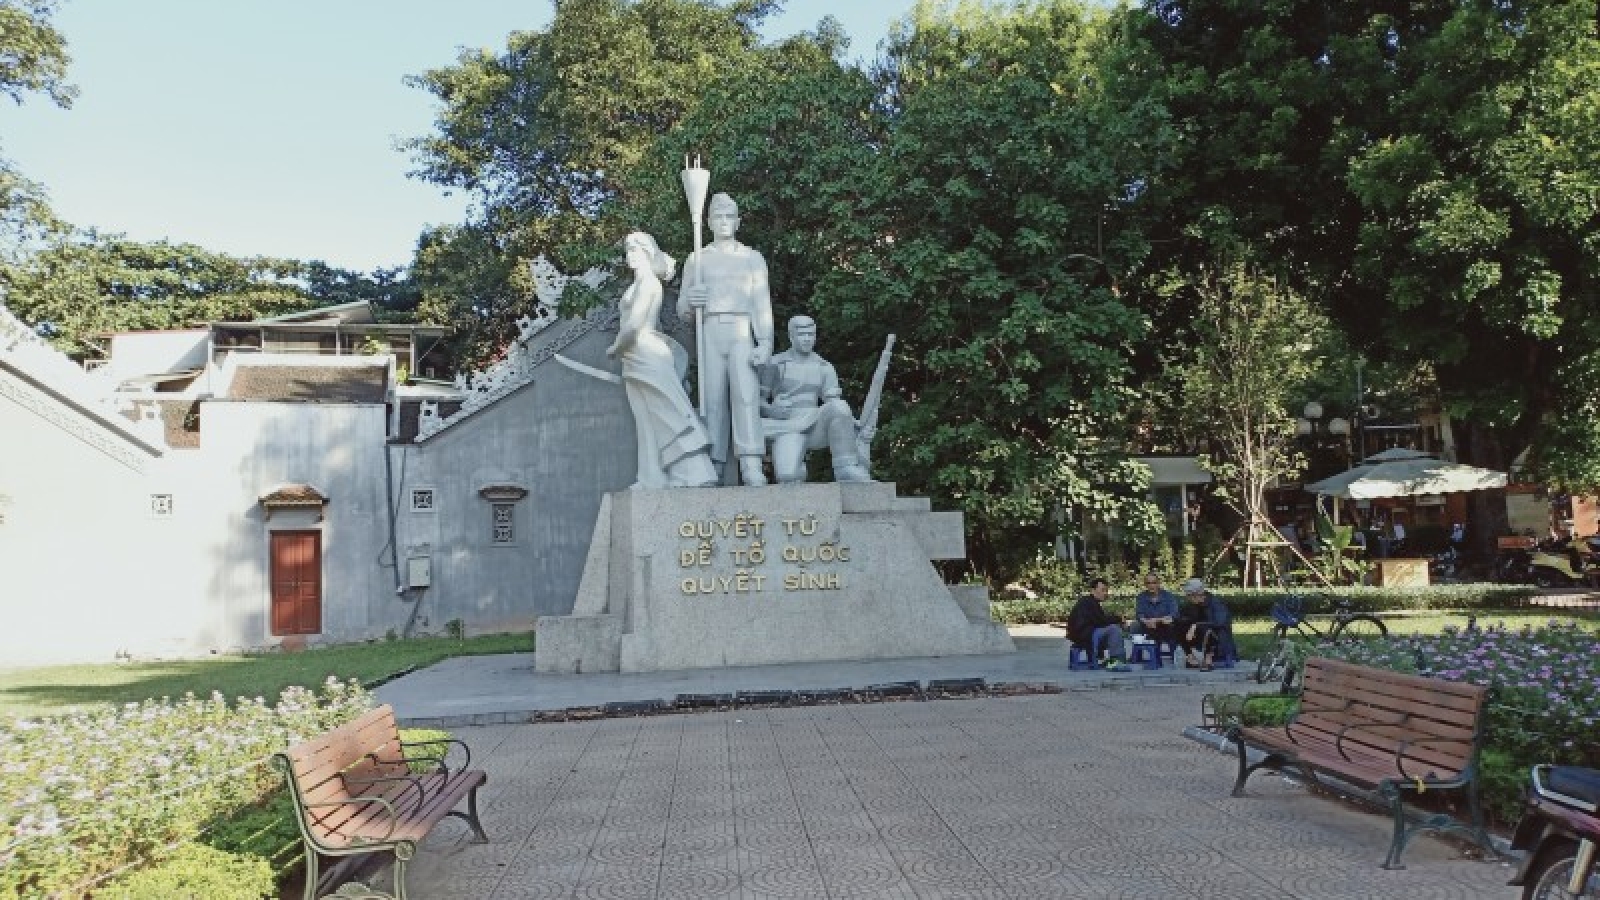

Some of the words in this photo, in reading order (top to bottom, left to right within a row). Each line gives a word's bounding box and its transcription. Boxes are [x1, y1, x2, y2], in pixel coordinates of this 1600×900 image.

[679, 513, 765, 538] QUYẾT
[731, 540, 767, 565] TỔ
[782, 540, 851, 563] QUỐC
[681, 568, 766, 595] QUYẾT
